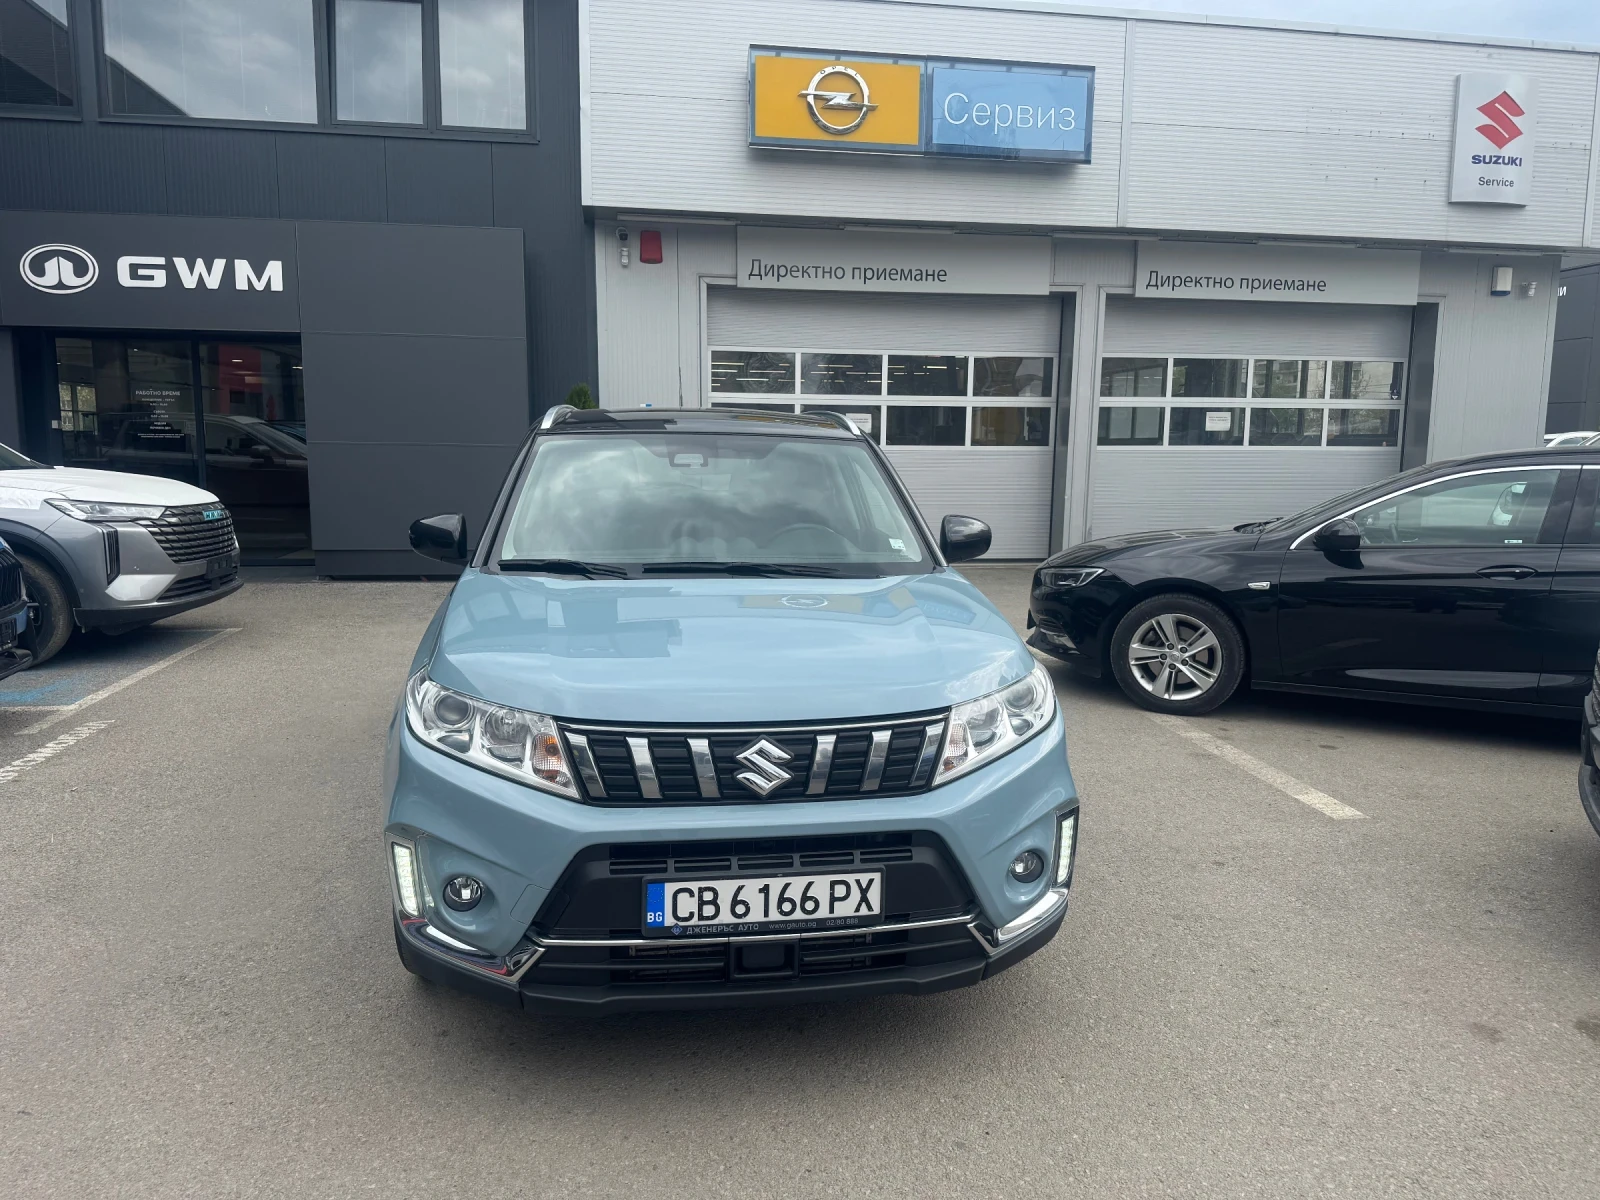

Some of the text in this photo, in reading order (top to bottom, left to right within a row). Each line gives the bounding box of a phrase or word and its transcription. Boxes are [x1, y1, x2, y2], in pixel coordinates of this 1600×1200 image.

[820, 66, 860, 77] OPEL
[944, 92, 1076, 135] Сервиз
[1471, 154, 1522, 167] SUZUKI
[1478, 176, 1514, 188] Service
[117, 255, 284, 291] GWM
[748, 259, 948, 284] Директно приемане
[1145, 271, 1327, 293] Директно приемане
[671, 878, 876, 922] CB 6166 PX
[647, 911, 663, 923] BG
[738, 923, 759, 931] АУТО
